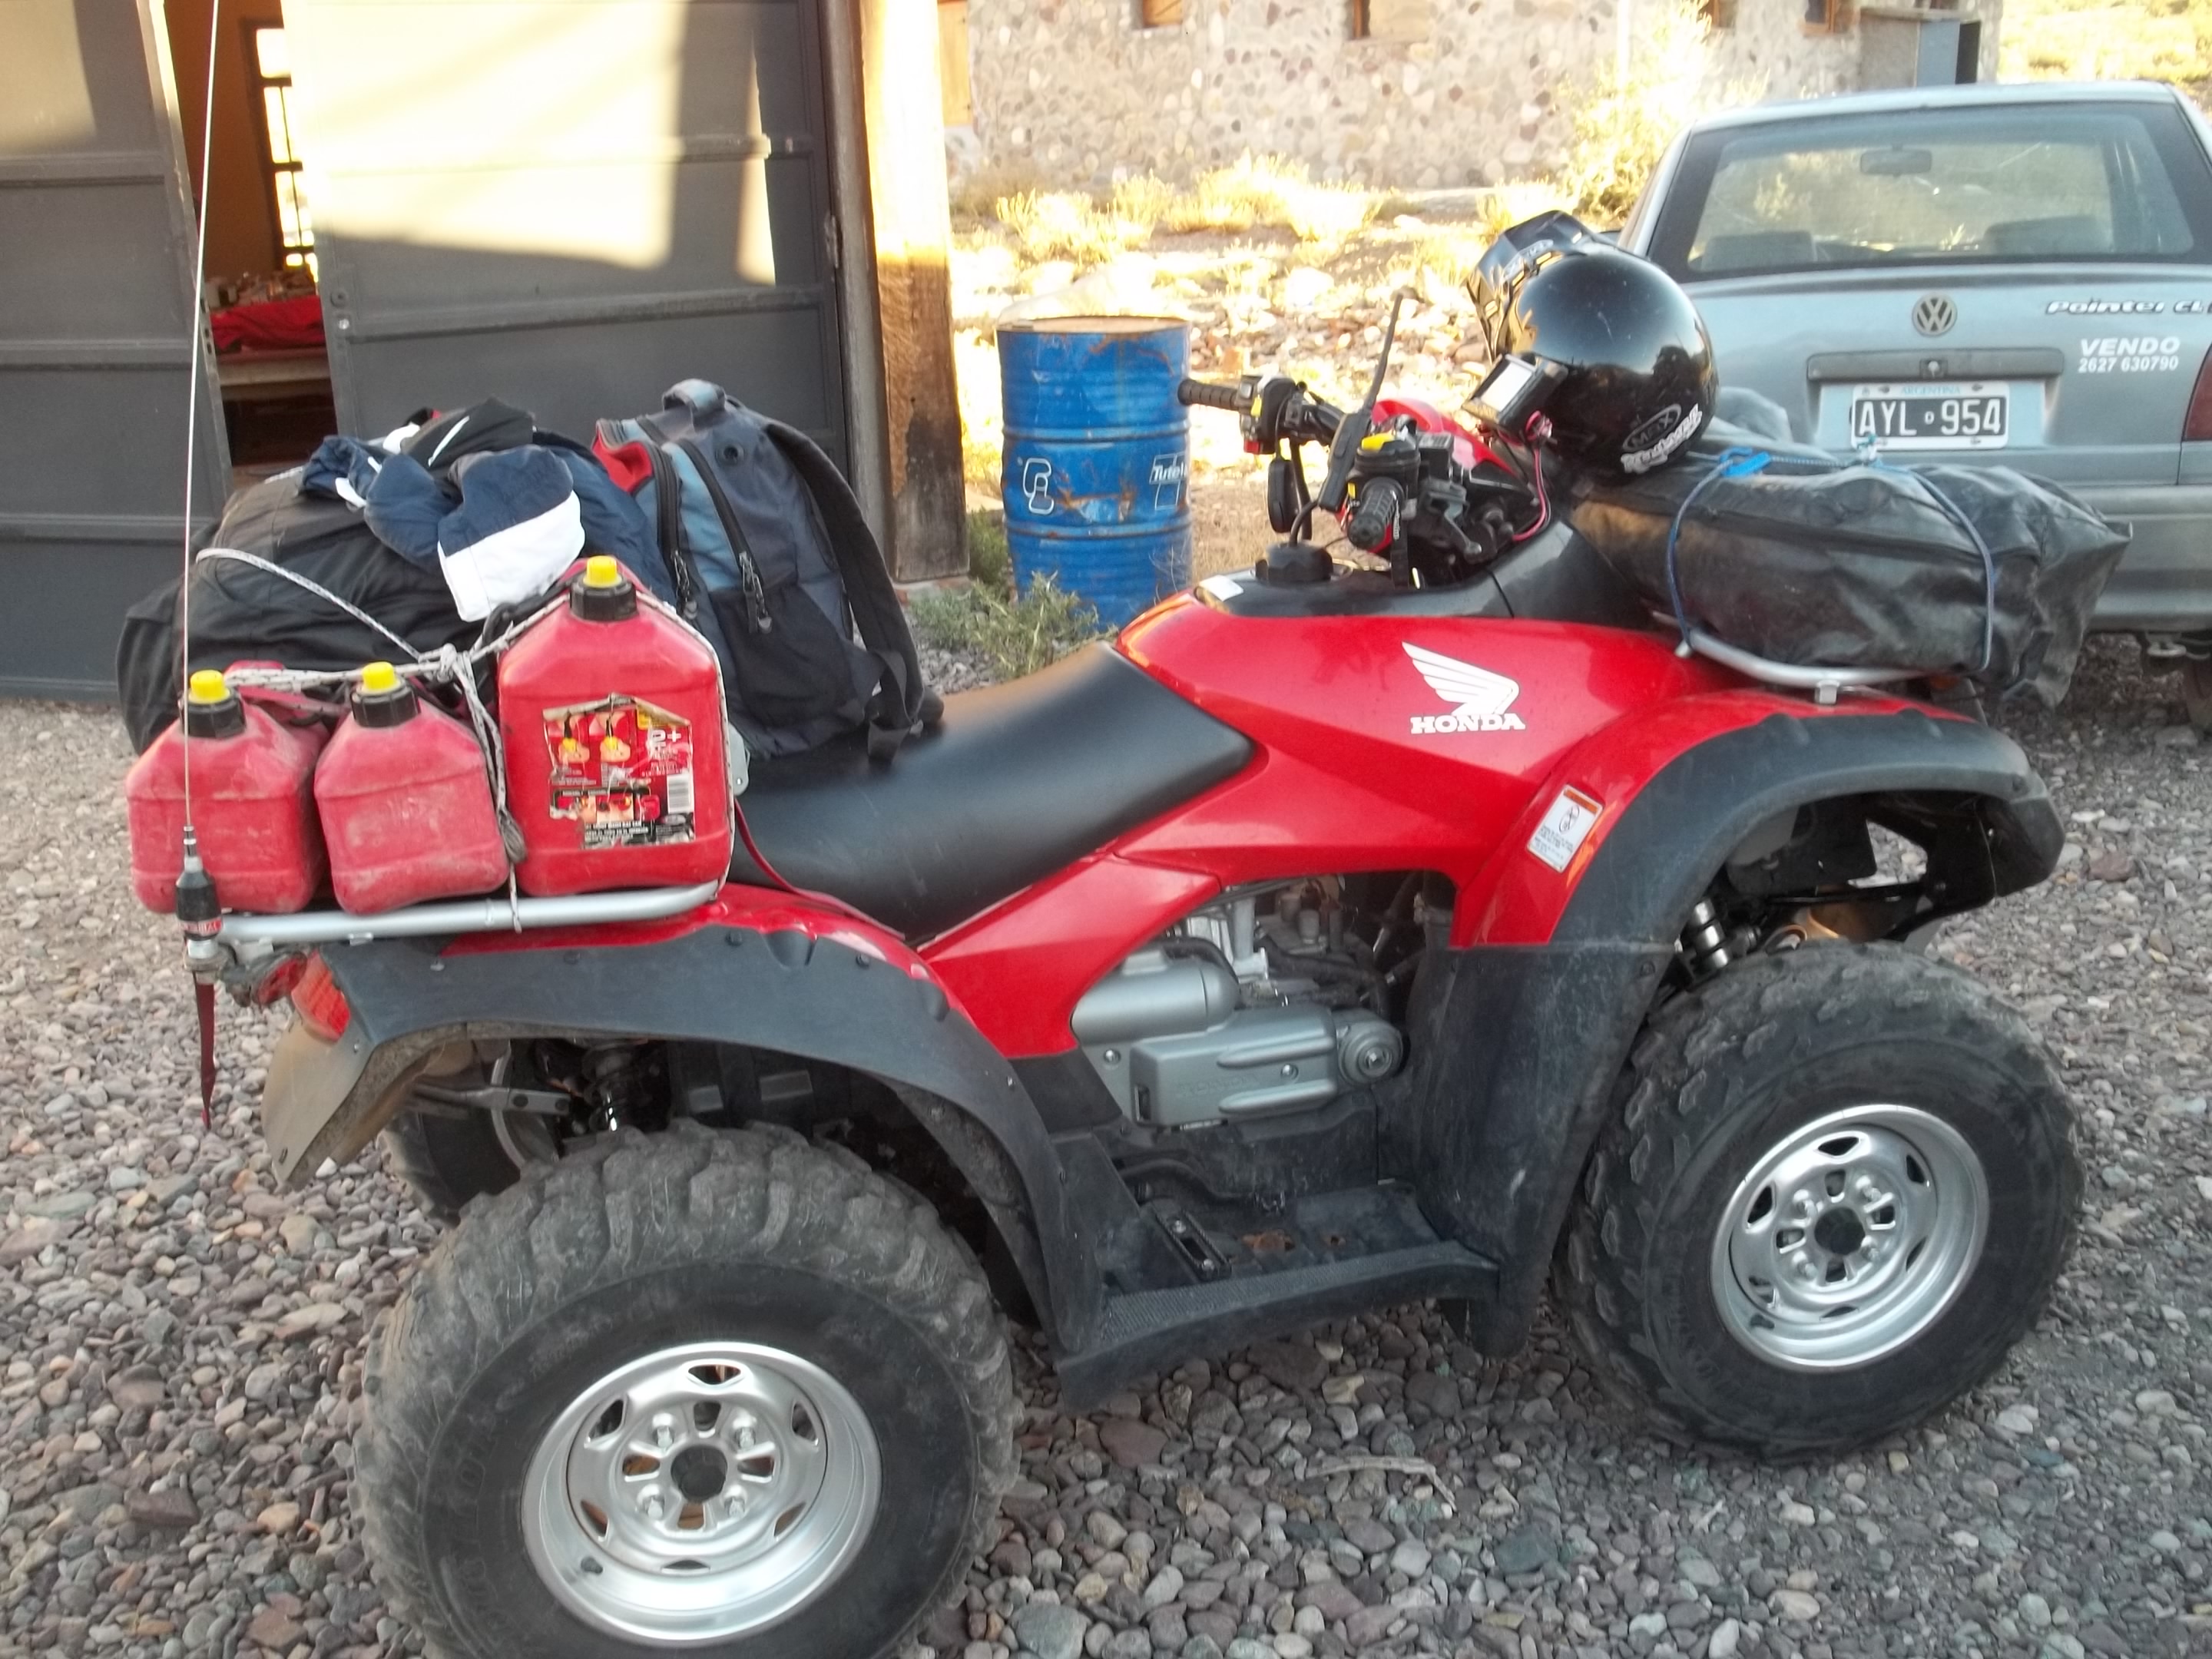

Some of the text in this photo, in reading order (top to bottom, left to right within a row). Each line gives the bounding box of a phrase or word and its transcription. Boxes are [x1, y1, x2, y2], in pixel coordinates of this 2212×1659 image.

[2046, 298, 2165, 314] Pointer
[2080, 336, 2181, 357] VENDO
[2078, 356, 2180, 373] 2627 630790
[1900, 386, 1961, 396] ARGENTINA
[1859, 400, 1918, 436] AYL
[1940, 398, 2002, 435] 954
[1410, 712, 1526, 734] HONDA
